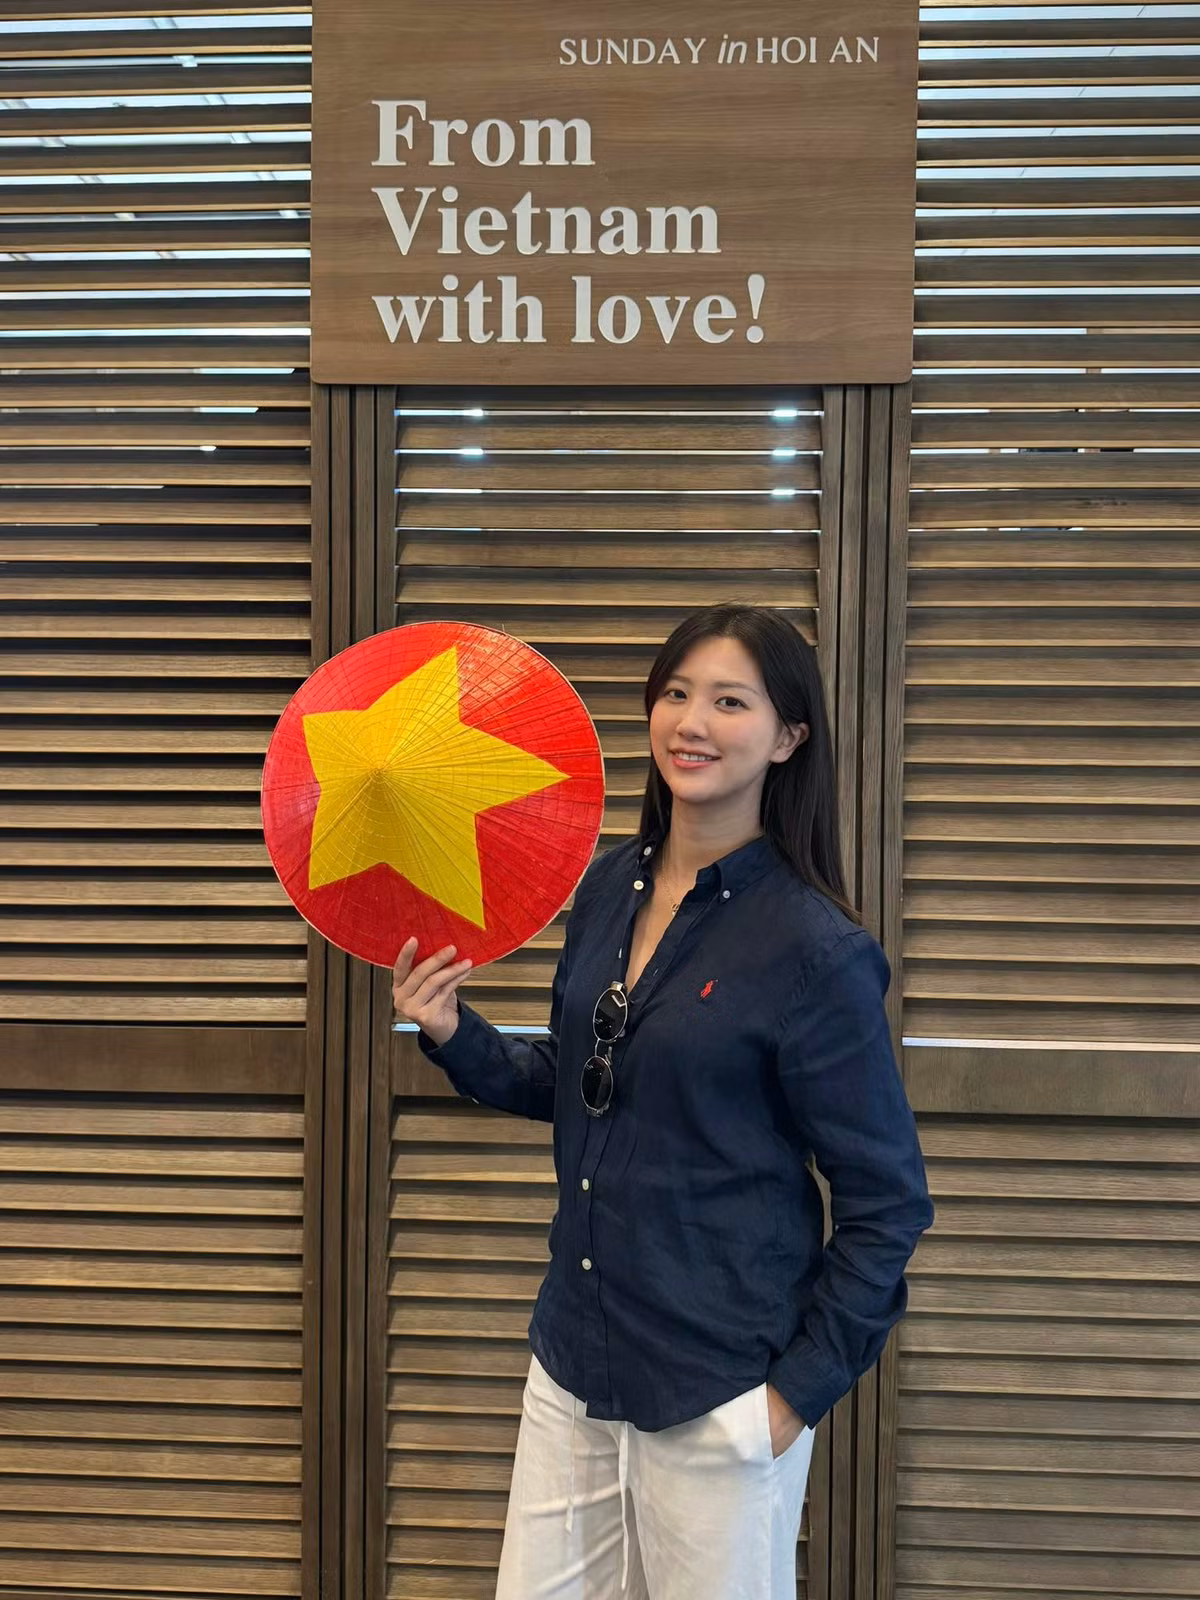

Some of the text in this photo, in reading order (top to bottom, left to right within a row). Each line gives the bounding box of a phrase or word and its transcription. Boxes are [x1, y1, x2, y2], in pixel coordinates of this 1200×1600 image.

[558, 34, 880, 66] SUNDAY in HOI AN
[371, 99, 596, 167] From
[371, 186, 722, 256] Vietnam
[371, 273, 766, 344] with love!
